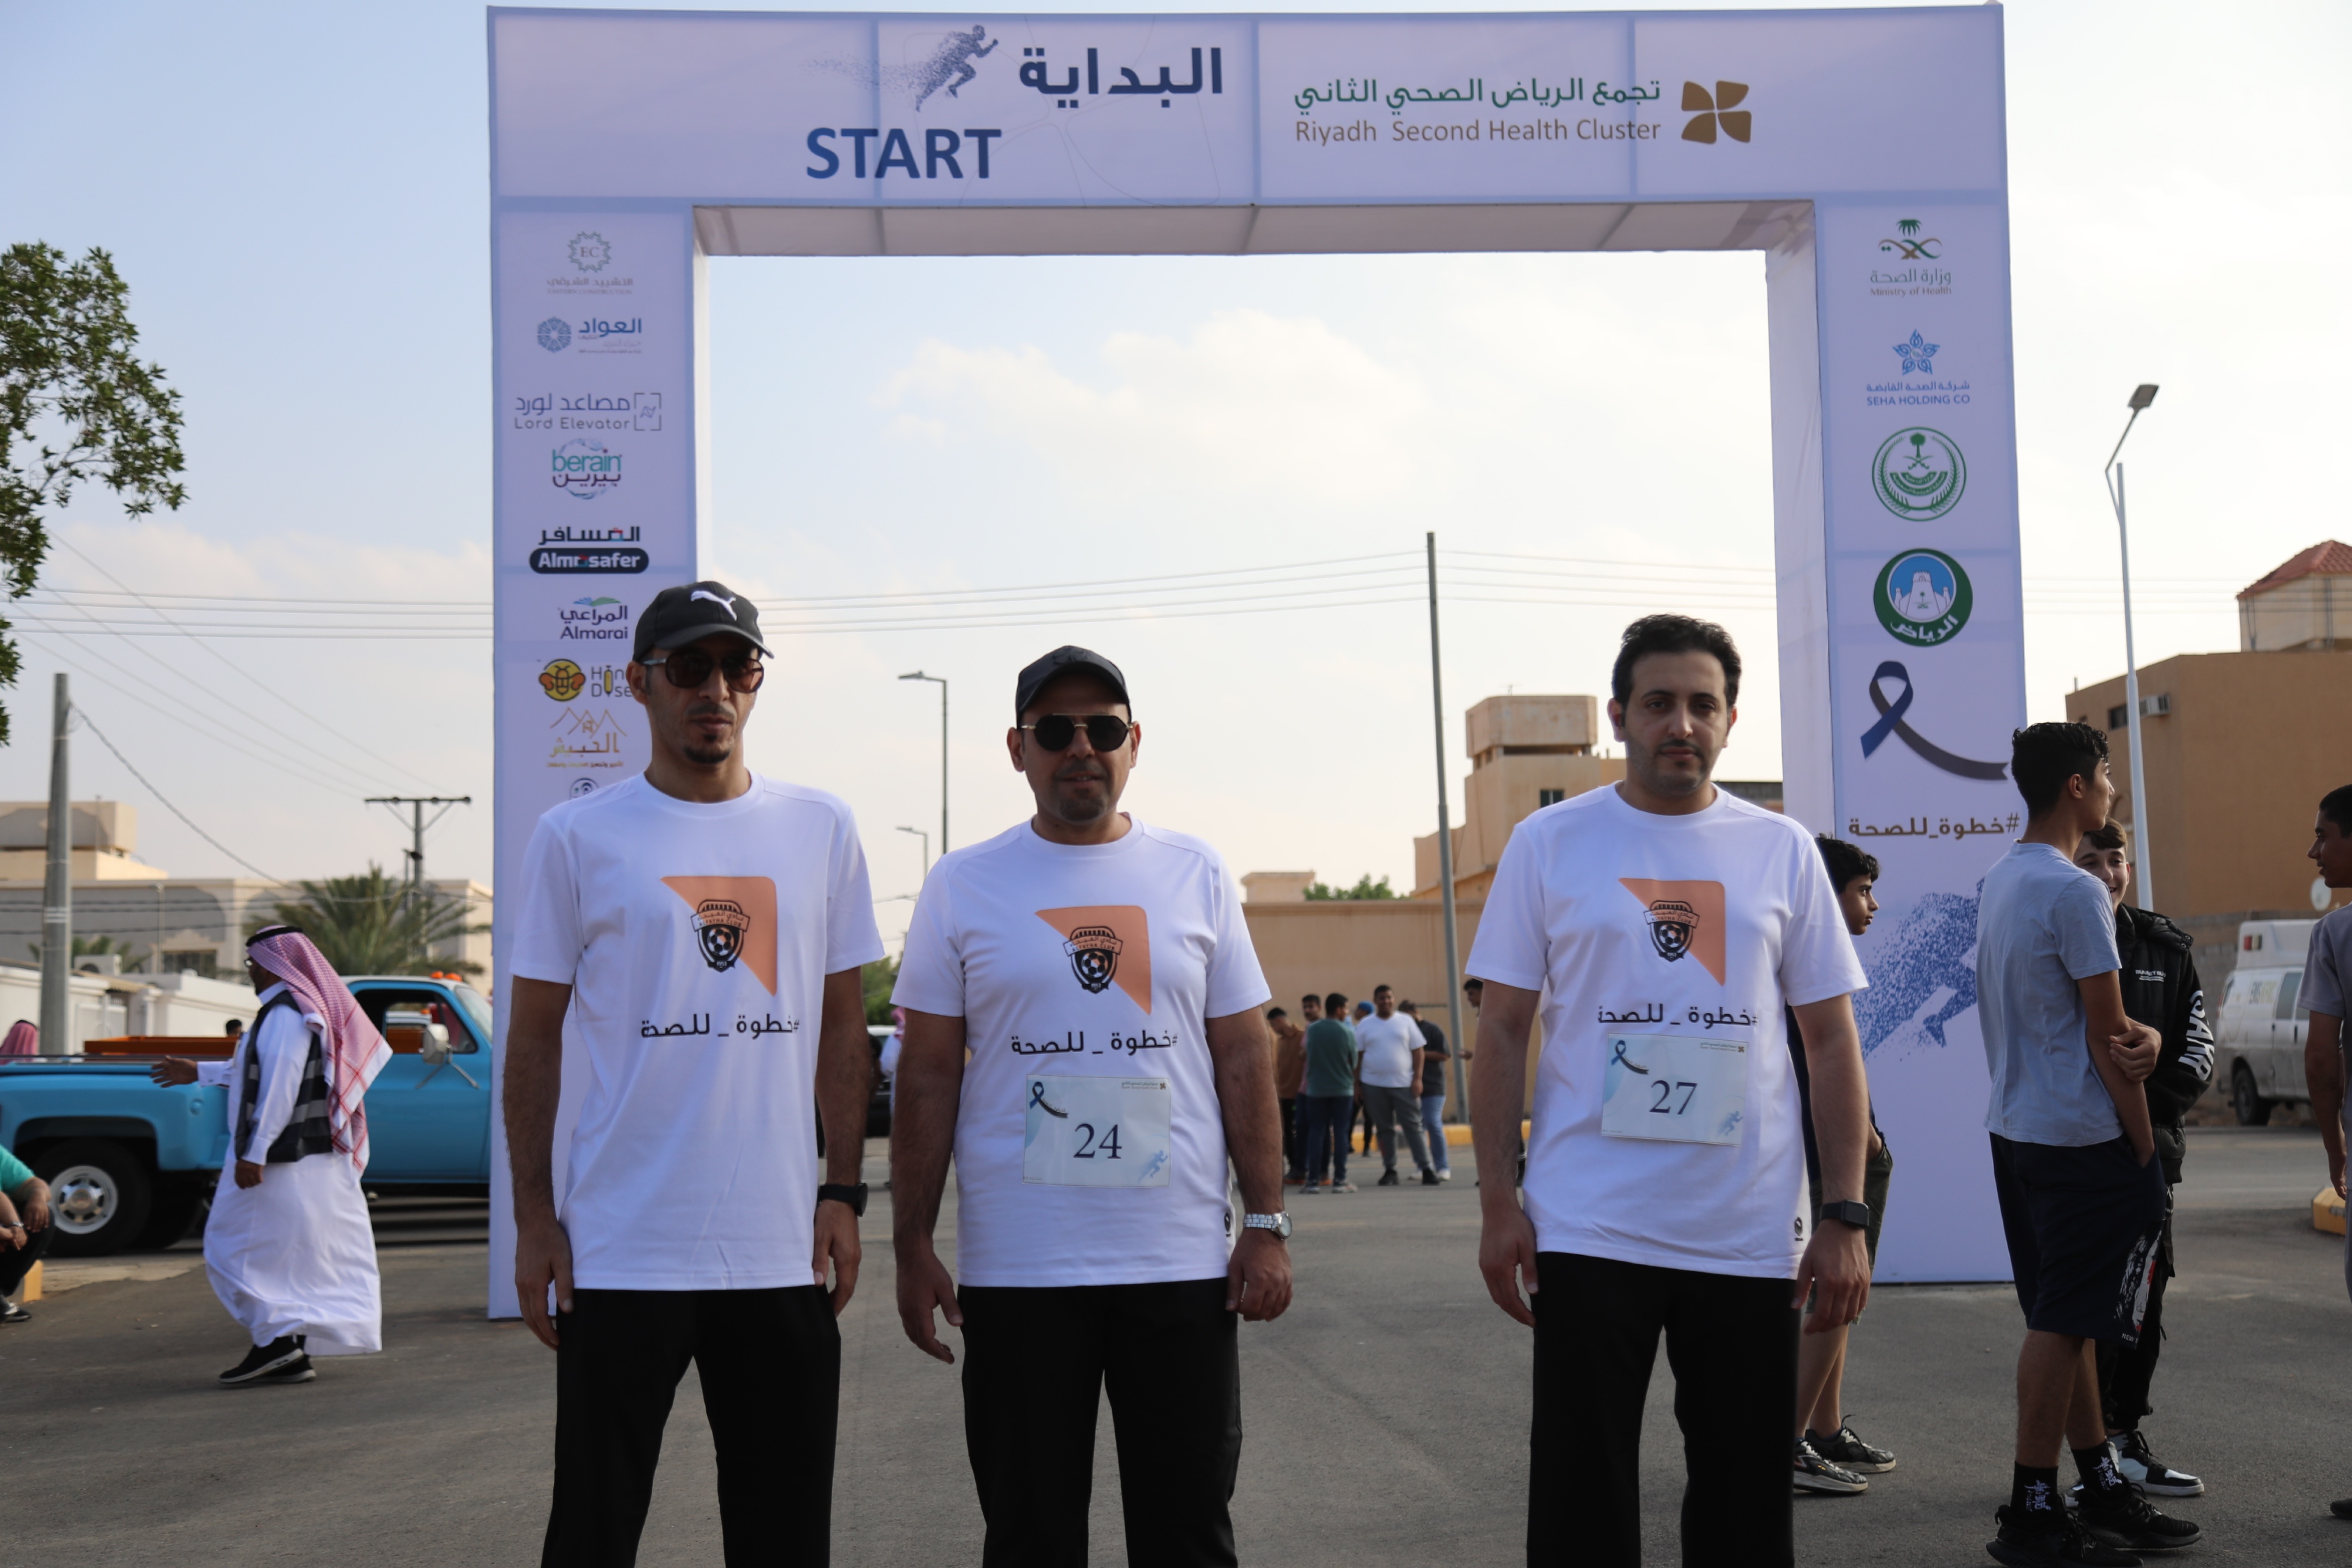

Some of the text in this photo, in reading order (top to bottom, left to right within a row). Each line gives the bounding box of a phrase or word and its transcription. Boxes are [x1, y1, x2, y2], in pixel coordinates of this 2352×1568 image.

[1019, 47, 1222, 108] البداية
[1295, 77, 1660, 116] تجمع الرياض الصحي الثاني
[1296, 118, 1661, 147] Riyadh Second Health Cluster
[807, 128, 1002, 179] START
[580, 247, 599, 257] EC
[1870, 268, 1951, 286] وزارة الصحة
[1870, 286, 1952, 298] Ministry of Health
[579, 318, 641, 338] العواد
[1906, 381, 1937, 391] الصحة
[1938, 380, 1970, 392] شركة
[515, 393, 630, 415] مصاعد لورد
[1867, 394, 1970, 406] SEHA HOLDING CO
[514, 417, 630, 430] Lord Elevator
[552, 448, 621, 472] berain
[552, 474, 621, 488] بيرين
[538, 526, 640, 546] المسافر
[560, 605, 628, 626] المراعي
[560, 626, 628, 640] Almarai
[1890, 614, 1959, 642] الرياض
[1849, 812, 2020, 840] #خطوة_للصحة
[1650, 1080, 1697, 1115] 27
[1073, 1123, 1122, 1159] 24
